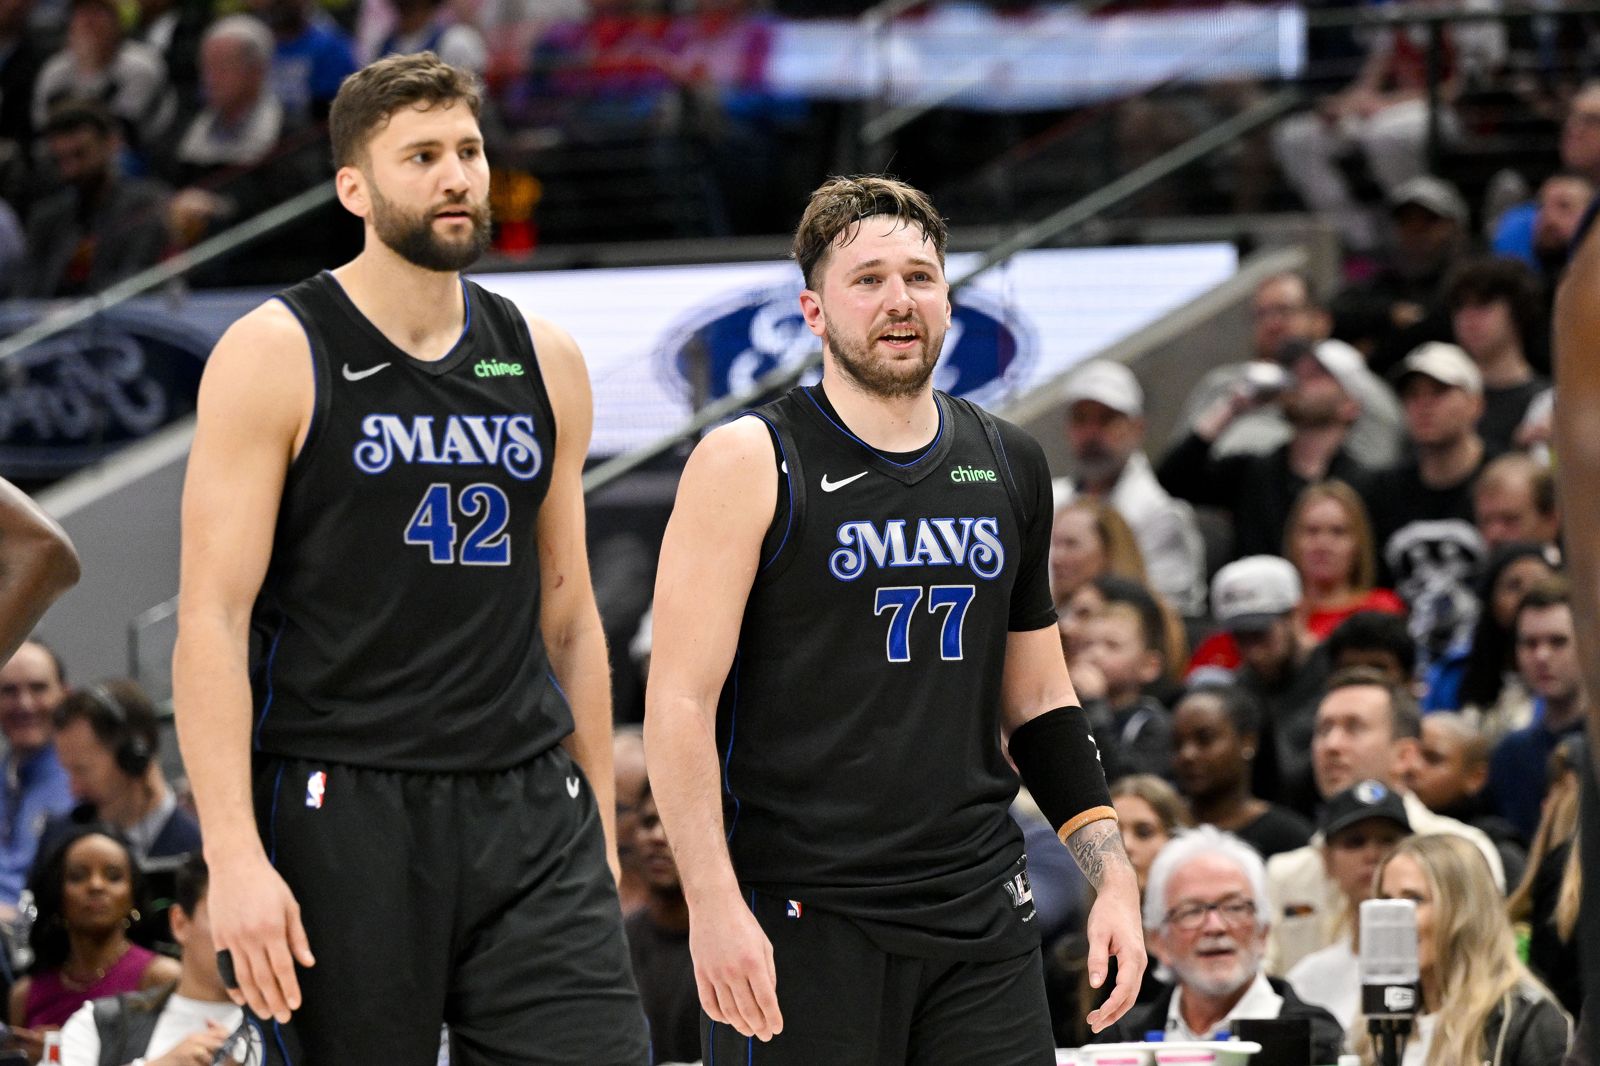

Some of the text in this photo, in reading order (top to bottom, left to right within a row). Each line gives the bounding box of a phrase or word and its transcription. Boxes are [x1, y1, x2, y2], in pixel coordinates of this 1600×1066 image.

[474, 360, 524, 378] chime
[354, 414, 542, 480] MAVS
[951, 466, 997, 483] chime
[404, 483, 511, 566] 42
[829, 517, 1005, 582] MAVS
[874, 585, 976, 662] 77
